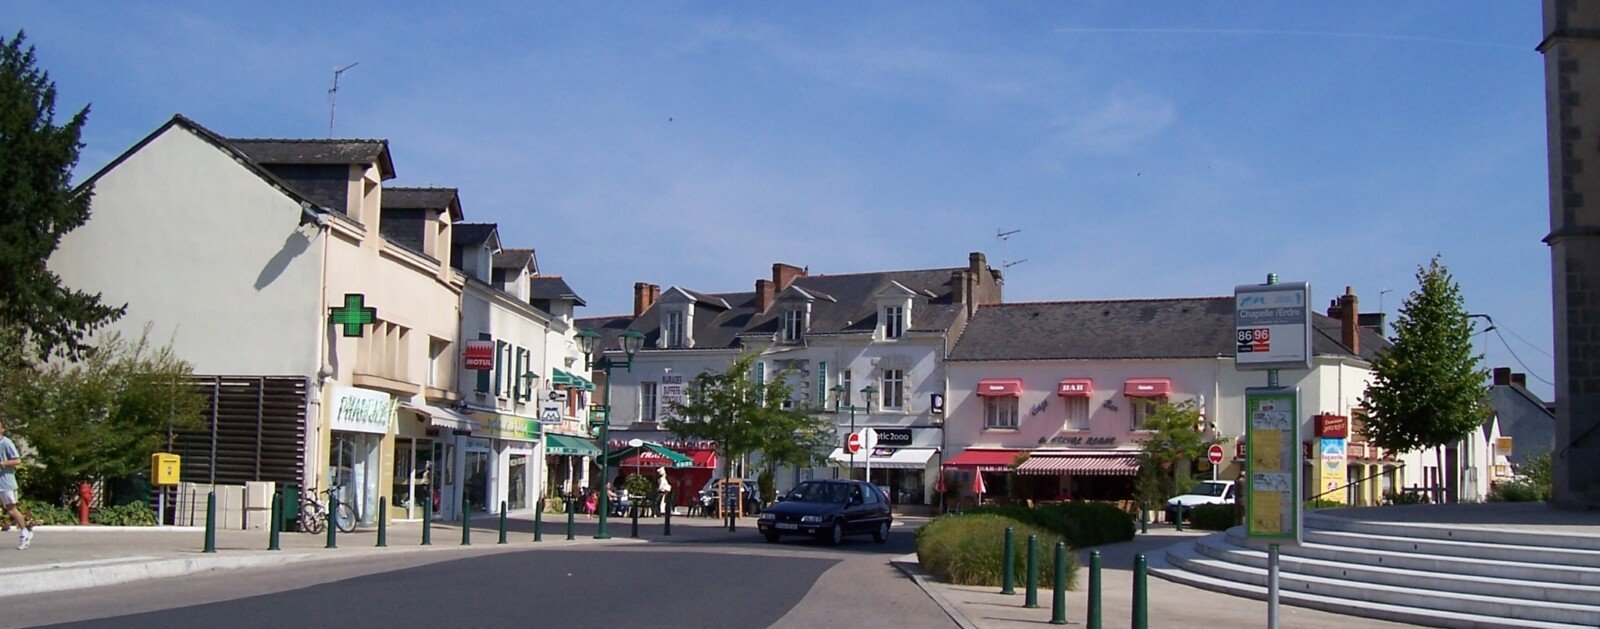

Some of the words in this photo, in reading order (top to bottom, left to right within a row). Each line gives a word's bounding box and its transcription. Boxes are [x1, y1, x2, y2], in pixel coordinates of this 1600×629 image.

[1240, 310, 1274, 324] Chapelle
[1238, 331, 1252, 341] 86
[1254, 330, 1269, 340] 96
[466, 358, 492, 366] MOTUL
